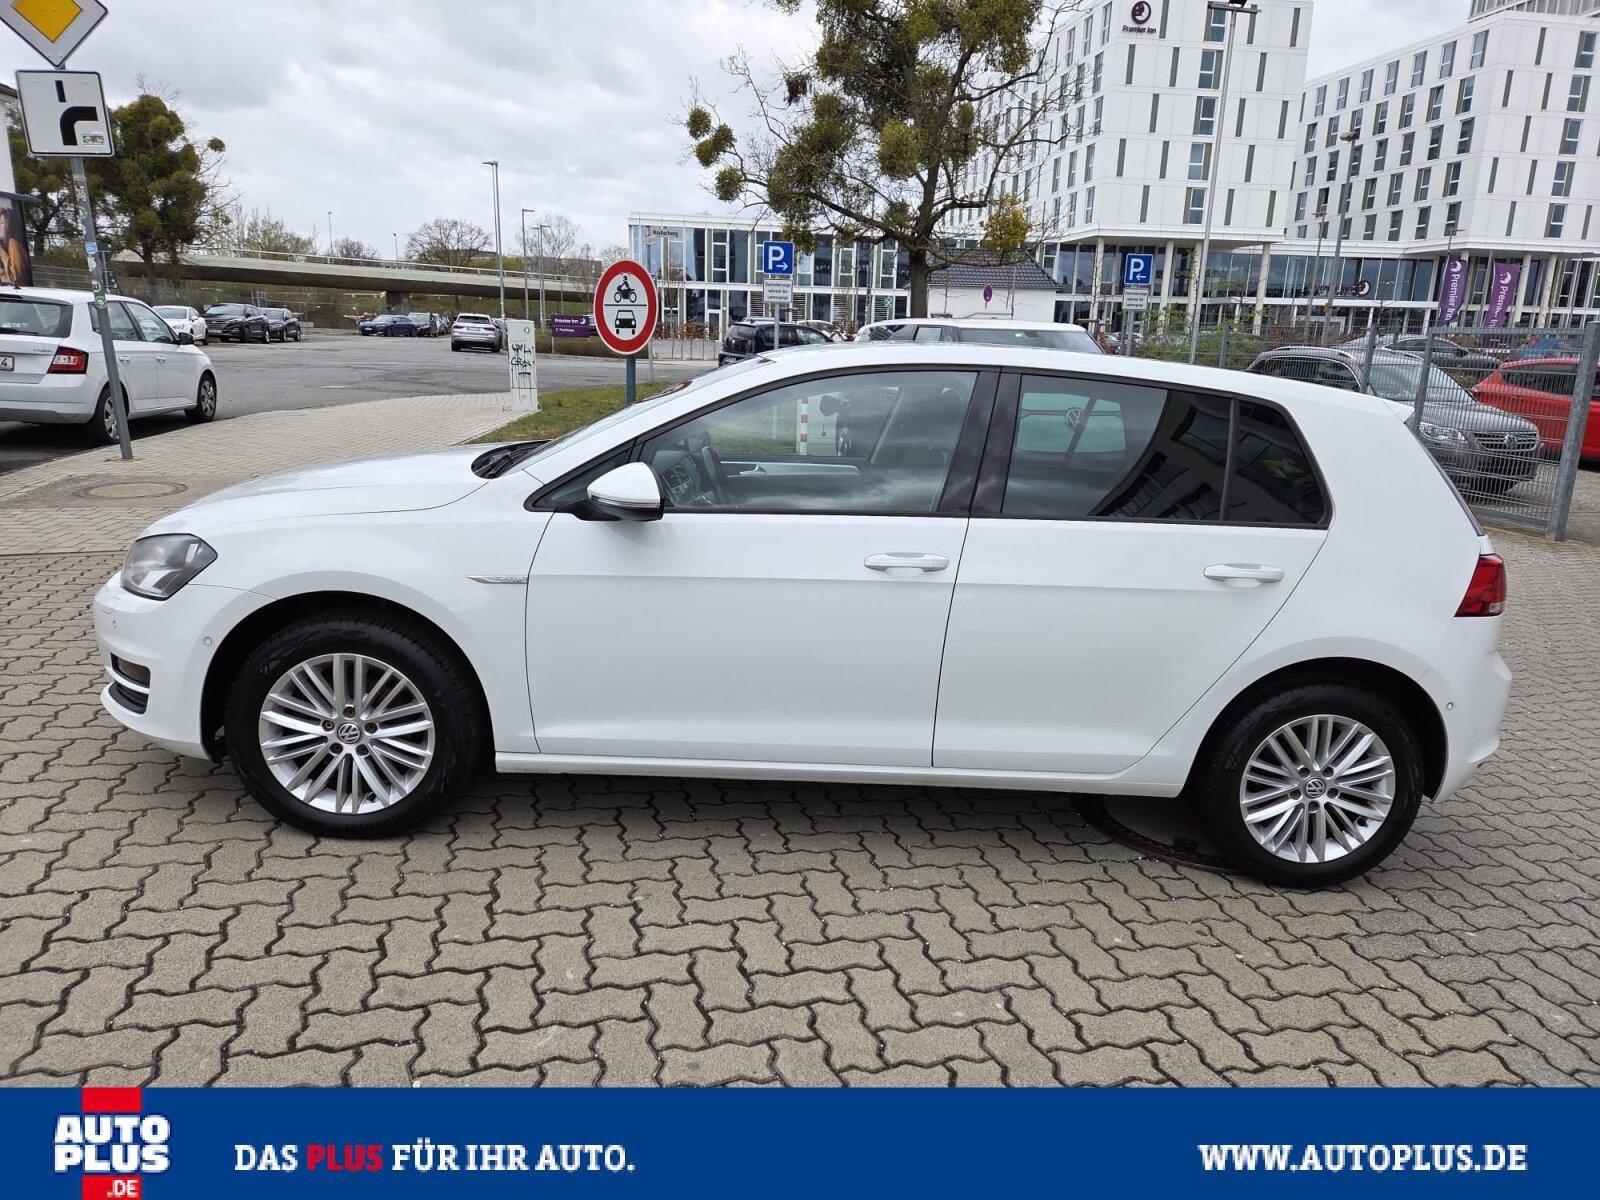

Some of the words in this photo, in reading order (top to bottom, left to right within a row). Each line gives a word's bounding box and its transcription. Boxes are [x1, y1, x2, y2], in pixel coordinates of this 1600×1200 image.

[1122, 24, 1146, 33] Premier
[1147, 26, 1157, 34] Inn
[768, 245, 785, 270] P
[1129, 258, 1145, 281] P
[1448, 273, 1461, 307] Premier
[1444, 308, 1456, 321] Inn
